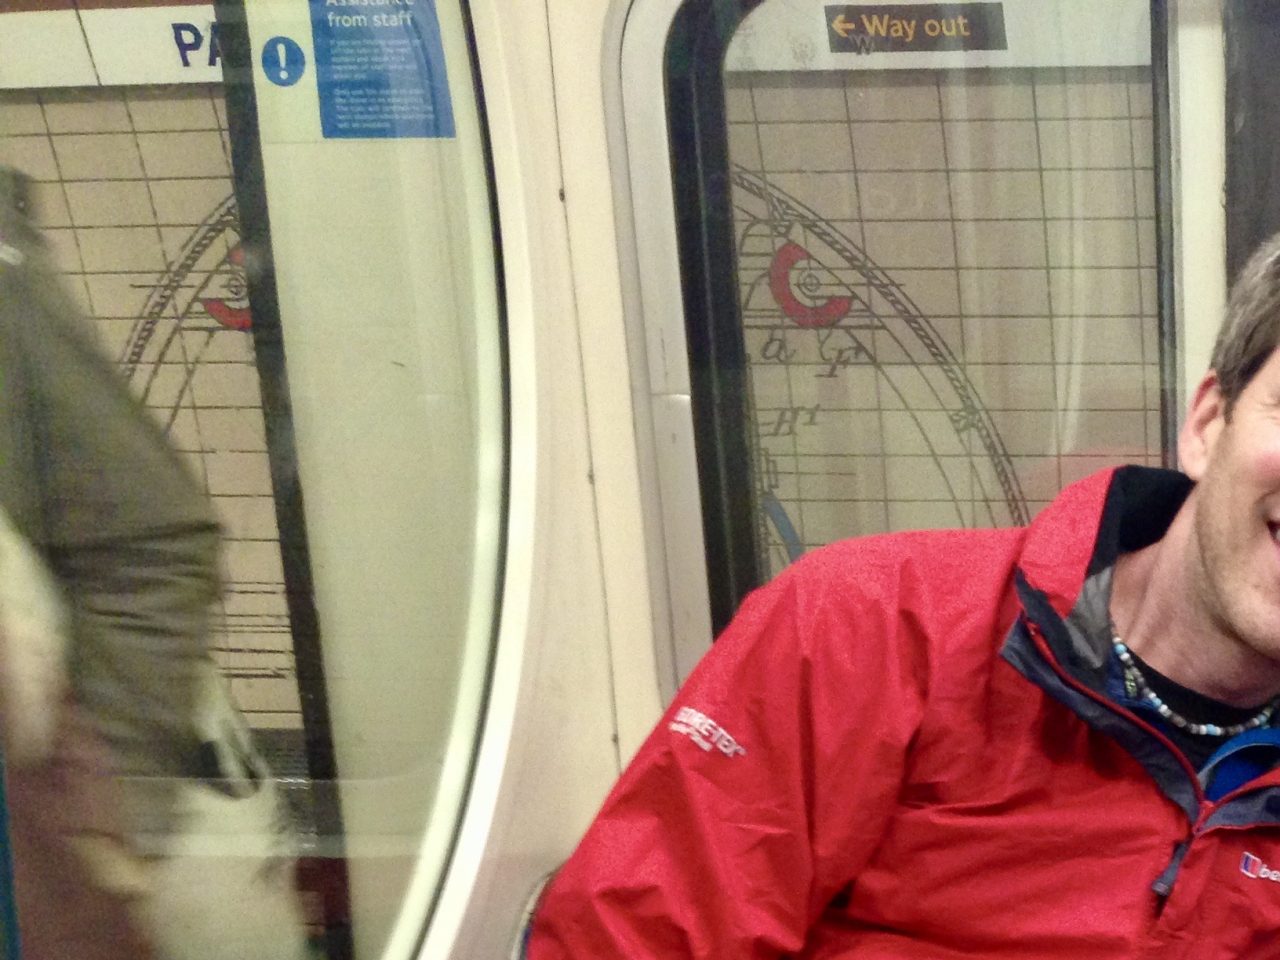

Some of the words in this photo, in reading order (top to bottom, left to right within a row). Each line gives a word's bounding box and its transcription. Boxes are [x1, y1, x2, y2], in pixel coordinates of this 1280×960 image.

[327, 11, 367, 27] from
[372, 10, 413, 27] staff
[861, 14, 916, 42] Way
[924, 15, 970, 37] out
